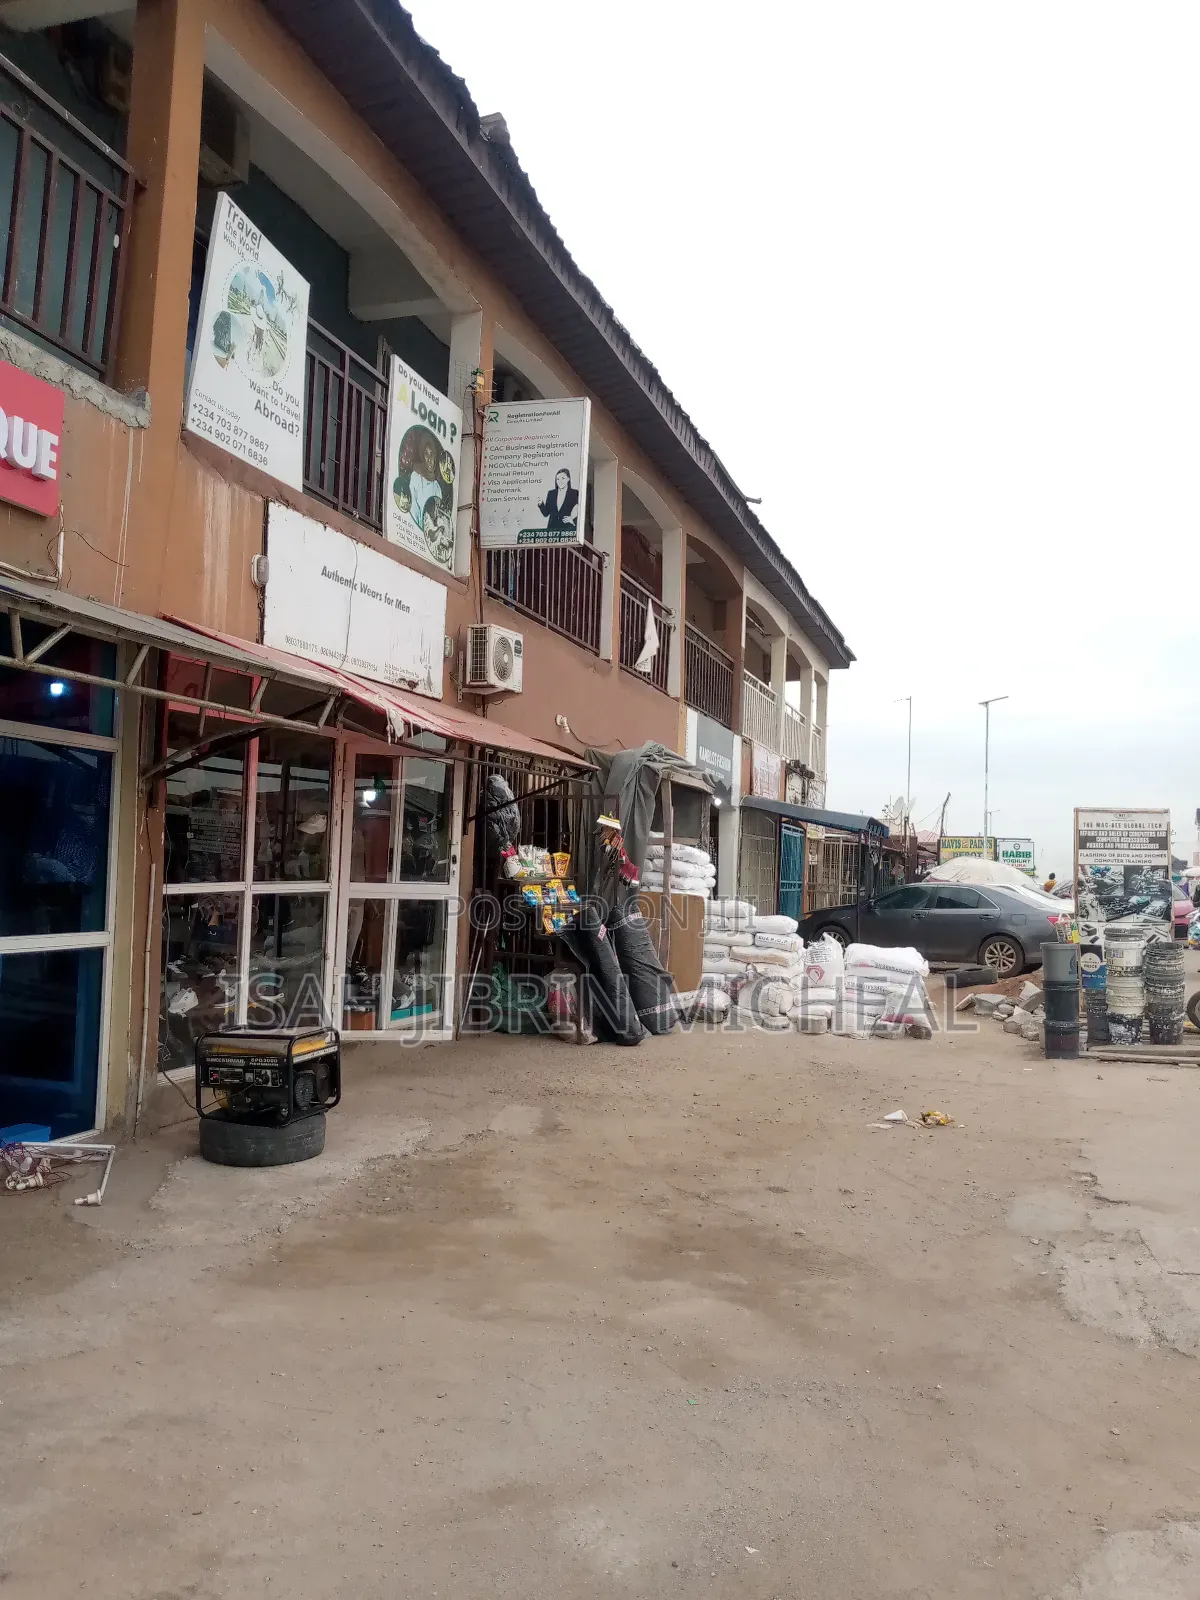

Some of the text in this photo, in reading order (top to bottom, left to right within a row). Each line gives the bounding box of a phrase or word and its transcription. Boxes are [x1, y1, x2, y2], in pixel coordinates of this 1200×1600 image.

[225, 221, 259, 261] the World
[227, 200, 262, 249] Travel
[248, 379, 301, 421] Want to travel
[272, 380, 300, 408] Do you
[399, 363, 440, 406] Do you Need
[192, 402, 269, 453] +234 703 877 9867
[254, 399, 300, 438] Abroad?
[190, 417, 268, 466] +234 902 071 6836
[489, 453, 521, 461] Company
[537, 442, 579, 450] Registration
[488, 460, 549, 469] NGO/Club/Church
[502, 478, 542, 486] Applications
[321, 565, 410, 614] Authentic Wears for Men
[942, 839, 961, 849] MAVIS
[1002, 850, 1032, 858] HABIB
